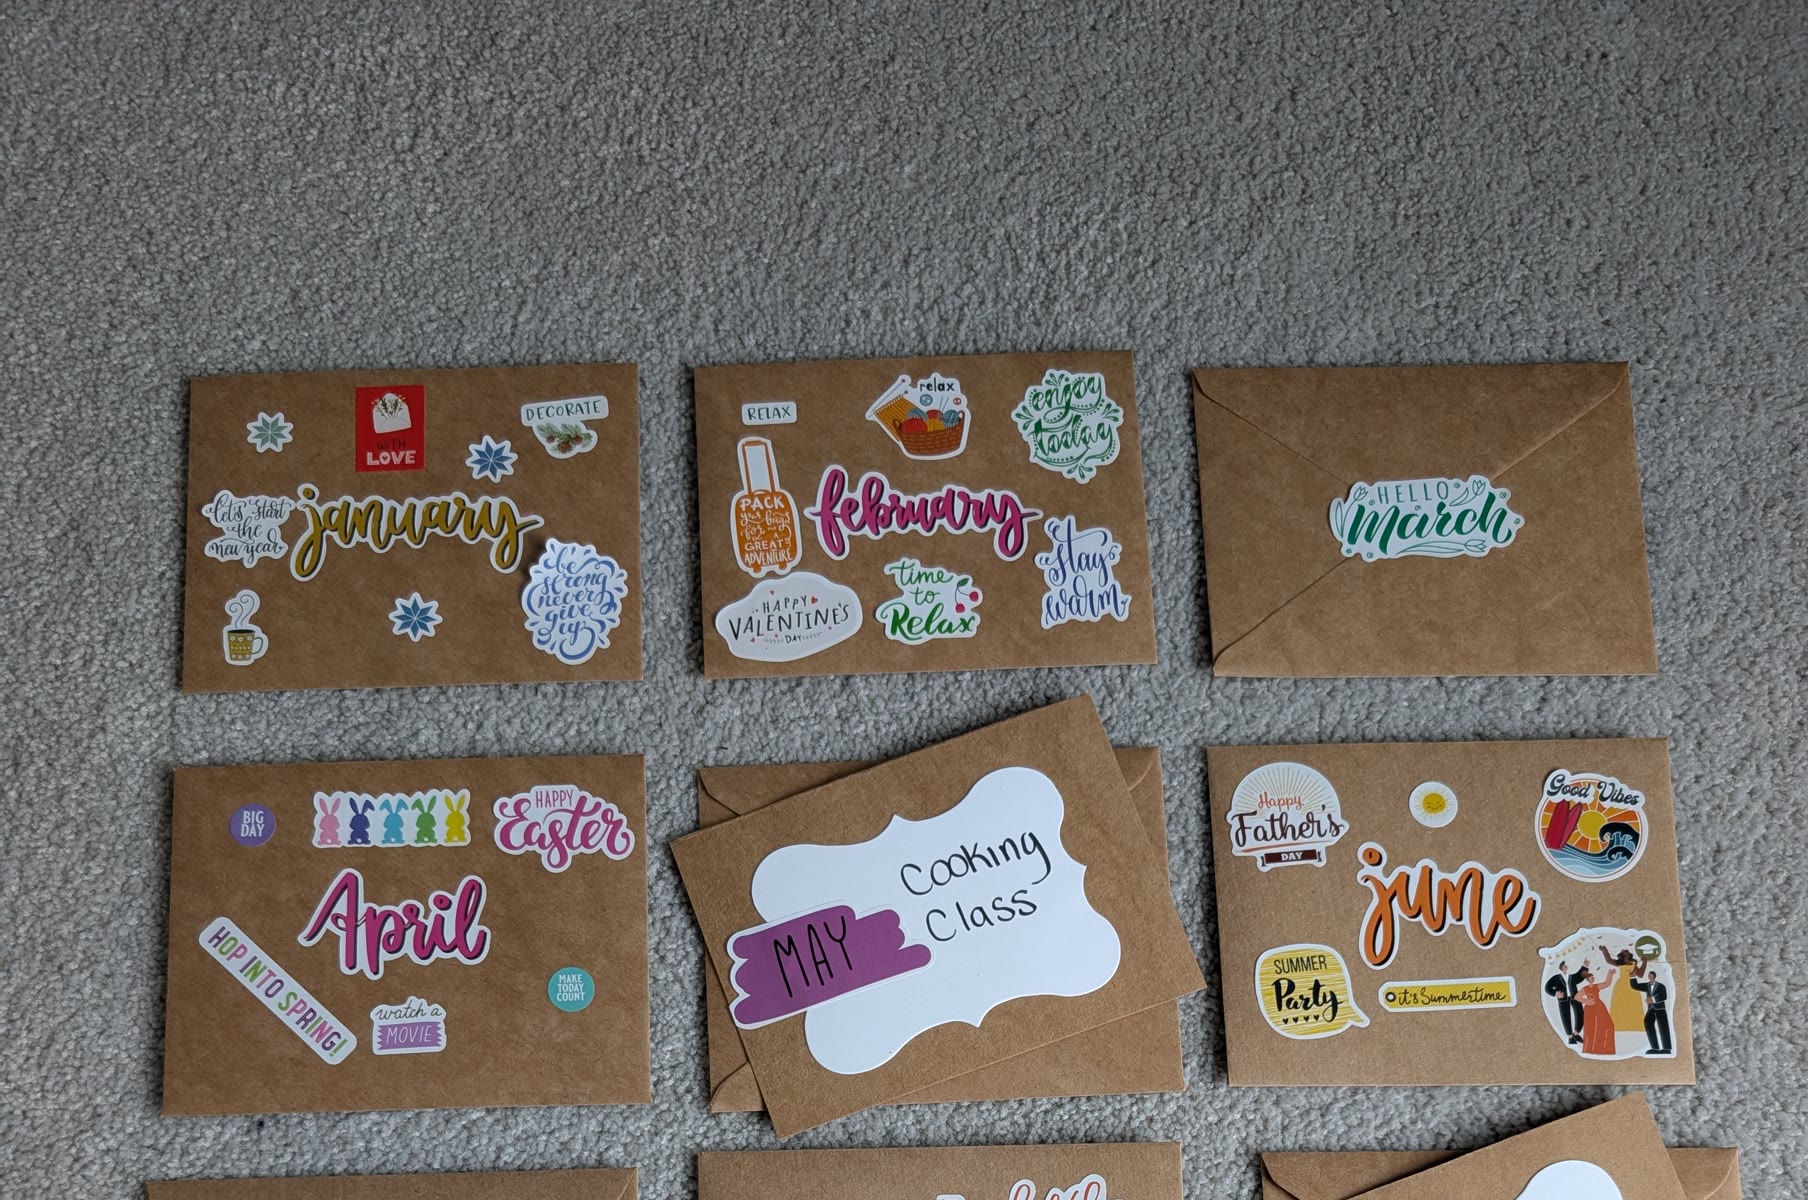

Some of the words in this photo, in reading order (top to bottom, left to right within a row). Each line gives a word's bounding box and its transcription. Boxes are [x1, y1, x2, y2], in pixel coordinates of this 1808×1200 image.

[919, 379, 955, 392] relax
[526, 400, 602, 421] DECORATE
[1032, 377, 1102, 423] enjoy
[747, 406, 792, 421] RELAX
[1028, 414, 1113, 459] today
[367, 450, 416, 466] LOVE
[1378, 482, 1449, 502] HELLO
[249, 499, 292, 520] start
[740, 496, 785, 511] PACK
[227, 516, 262, 540] the
[740, 511, 764, 526] your
[765, 510, 790, 531] bags
[209, 538, 252, 558] new
[244, 528, 285, 564] year
[745, 540, 783, 551] GREAT
[1040, 519, 1118, 587] stay
[543, 547, 600, 575] be
[745, 549, 792, 566] ADVENTURE
[889, 563, 952, 584] time
[533, 573, 610, 606] strong
[538, 588, 595, 609] never
[910, 586, 936, 605] to
[1046, 575, 1128, 625] warm
[763, 595, 807, 613] HAPPY
[538, 604, 593, 645] give
[729, 603, 849, 640] VALENTINE'S
[890, 603, 976, 641] Relax
[785, 635, 802, 643] DAY
[535, 789, 573, 807] HAPPY
[1547, 774, 1591, 798] Good
[1597, 781, 1640, 805] Vibes
[1258, 792, 1304, 812] Happy
[243, 810, 264, 824] BIG
[1231, 804, 1345, 847] Father's
[240, 823, 265, 838] DAY
[499, 796, 631, 868] Easter
[900, 832, 1051, 896] Cooking
[1281, 852, 1302, 861] DAY
[303, 872, 488, 975] April
[926, 889, 1037, 942] Class
[773, 915, 853, 998] MAY
[1274, 955, 1327, 974] SUMMER
[557, 983, 584, 993] TODAY
[558, 974, 583, 985] MAKE
[208, 926, 248, 961] HOP
[239, 956, 285, 998] INTO
[278, 991, 348, 1057] SPRING!
[556, 991, 585, 1002] COUNT
[1271, 977, 1344, 1021] Party
[376, 1000, 427, 1020] watch
[431, 1007, 443, 1016] a
[386, 1025, 432, 1044] MOVIE
